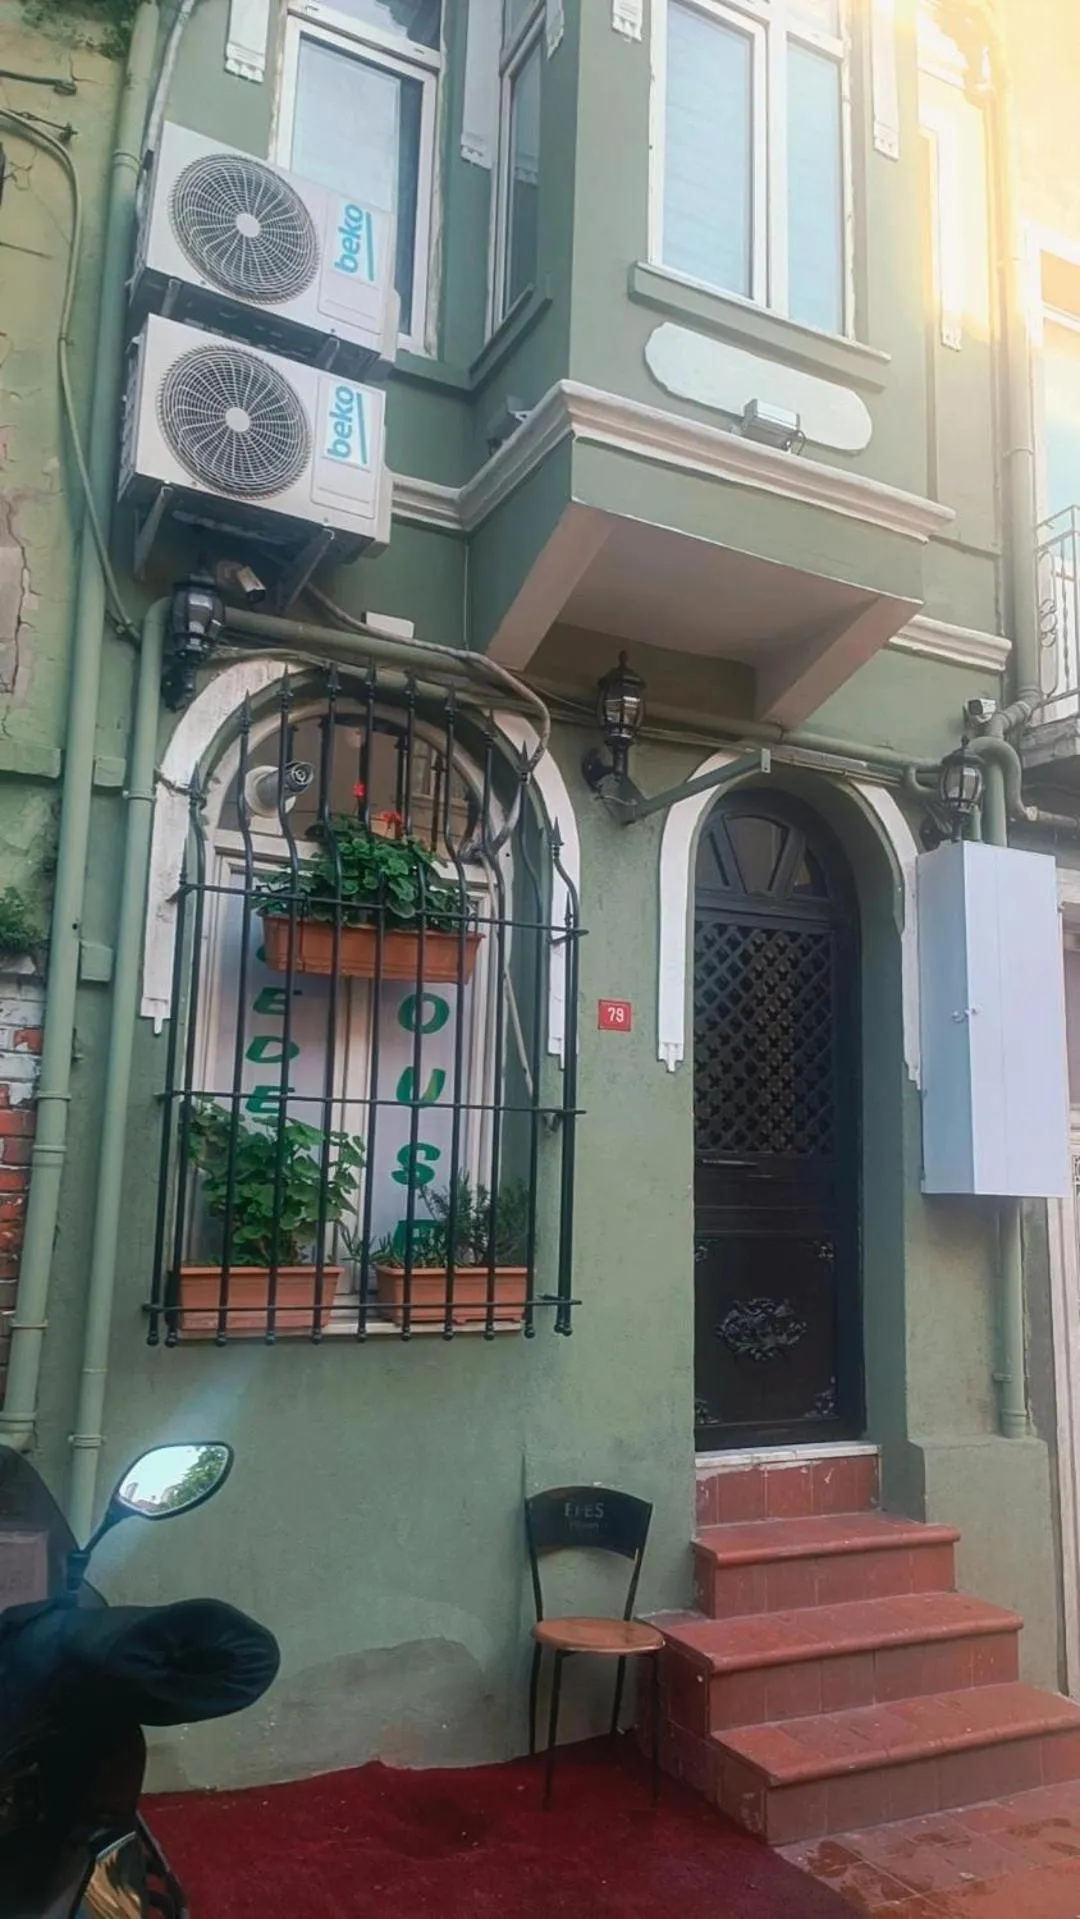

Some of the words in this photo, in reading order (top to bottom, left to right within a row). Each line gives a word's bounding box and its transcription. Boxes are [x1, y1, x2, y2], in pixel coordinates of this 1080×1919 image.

[334, 204, 363, 273] beko
[327, 386, 354, 458] beko
[607, 1006, 625, 1023] 79
